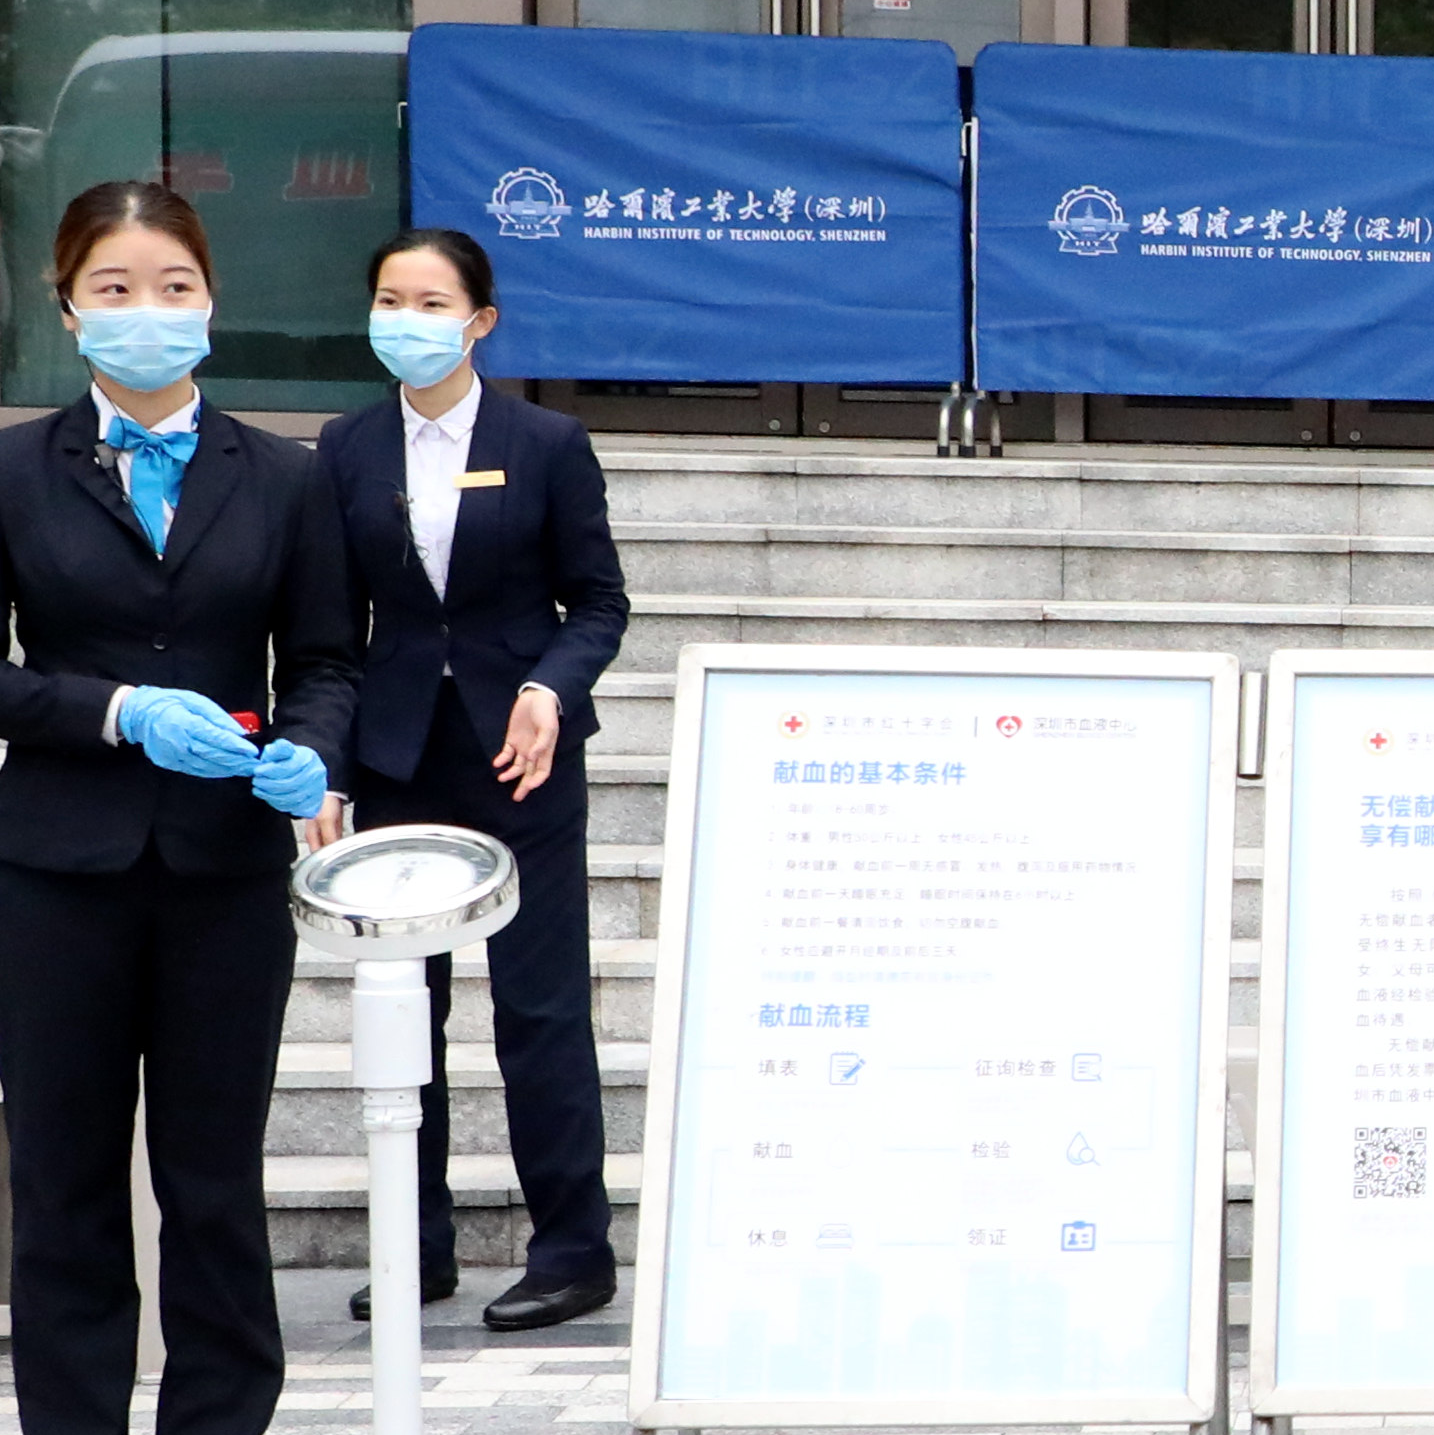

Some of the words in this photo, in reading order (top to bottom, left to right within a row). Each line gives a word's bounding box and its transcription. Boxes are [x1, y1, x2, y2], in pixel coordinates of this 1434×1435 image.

[584, 226, 633, 239] HARBIN
[638, 226, 701, 241] INSTITUTE
[707, 228, 723, 241] OF
[820, 229, 886, 242] SHENZHEN
[1141, 244, 1187, 257] HARBIN
[1192, 245, 1253, 258] INSTITUTE
[1258, 245, 1275, 259] OF
[1366, 249, 1431, 263] SHENZHEN
[823, 715, 953, 730] 深圳市红十字会
[1033, 716, 1137, 732] 深圳市血液中心
[772, 759, 968, 786] 献血的基本条件
[757, 1002, 873, 1029] 献血流程
[758, 1058, 800, 1078] 填表
[974, 1057, 1057, 1078] 征询检查
[752, 1141, 794, 1161] 献血
[970, 1141, 1012, 1161] 检验
[747, 1228, 789, 1248] 休息
[967, 1227, 1009, 1248] 领证
